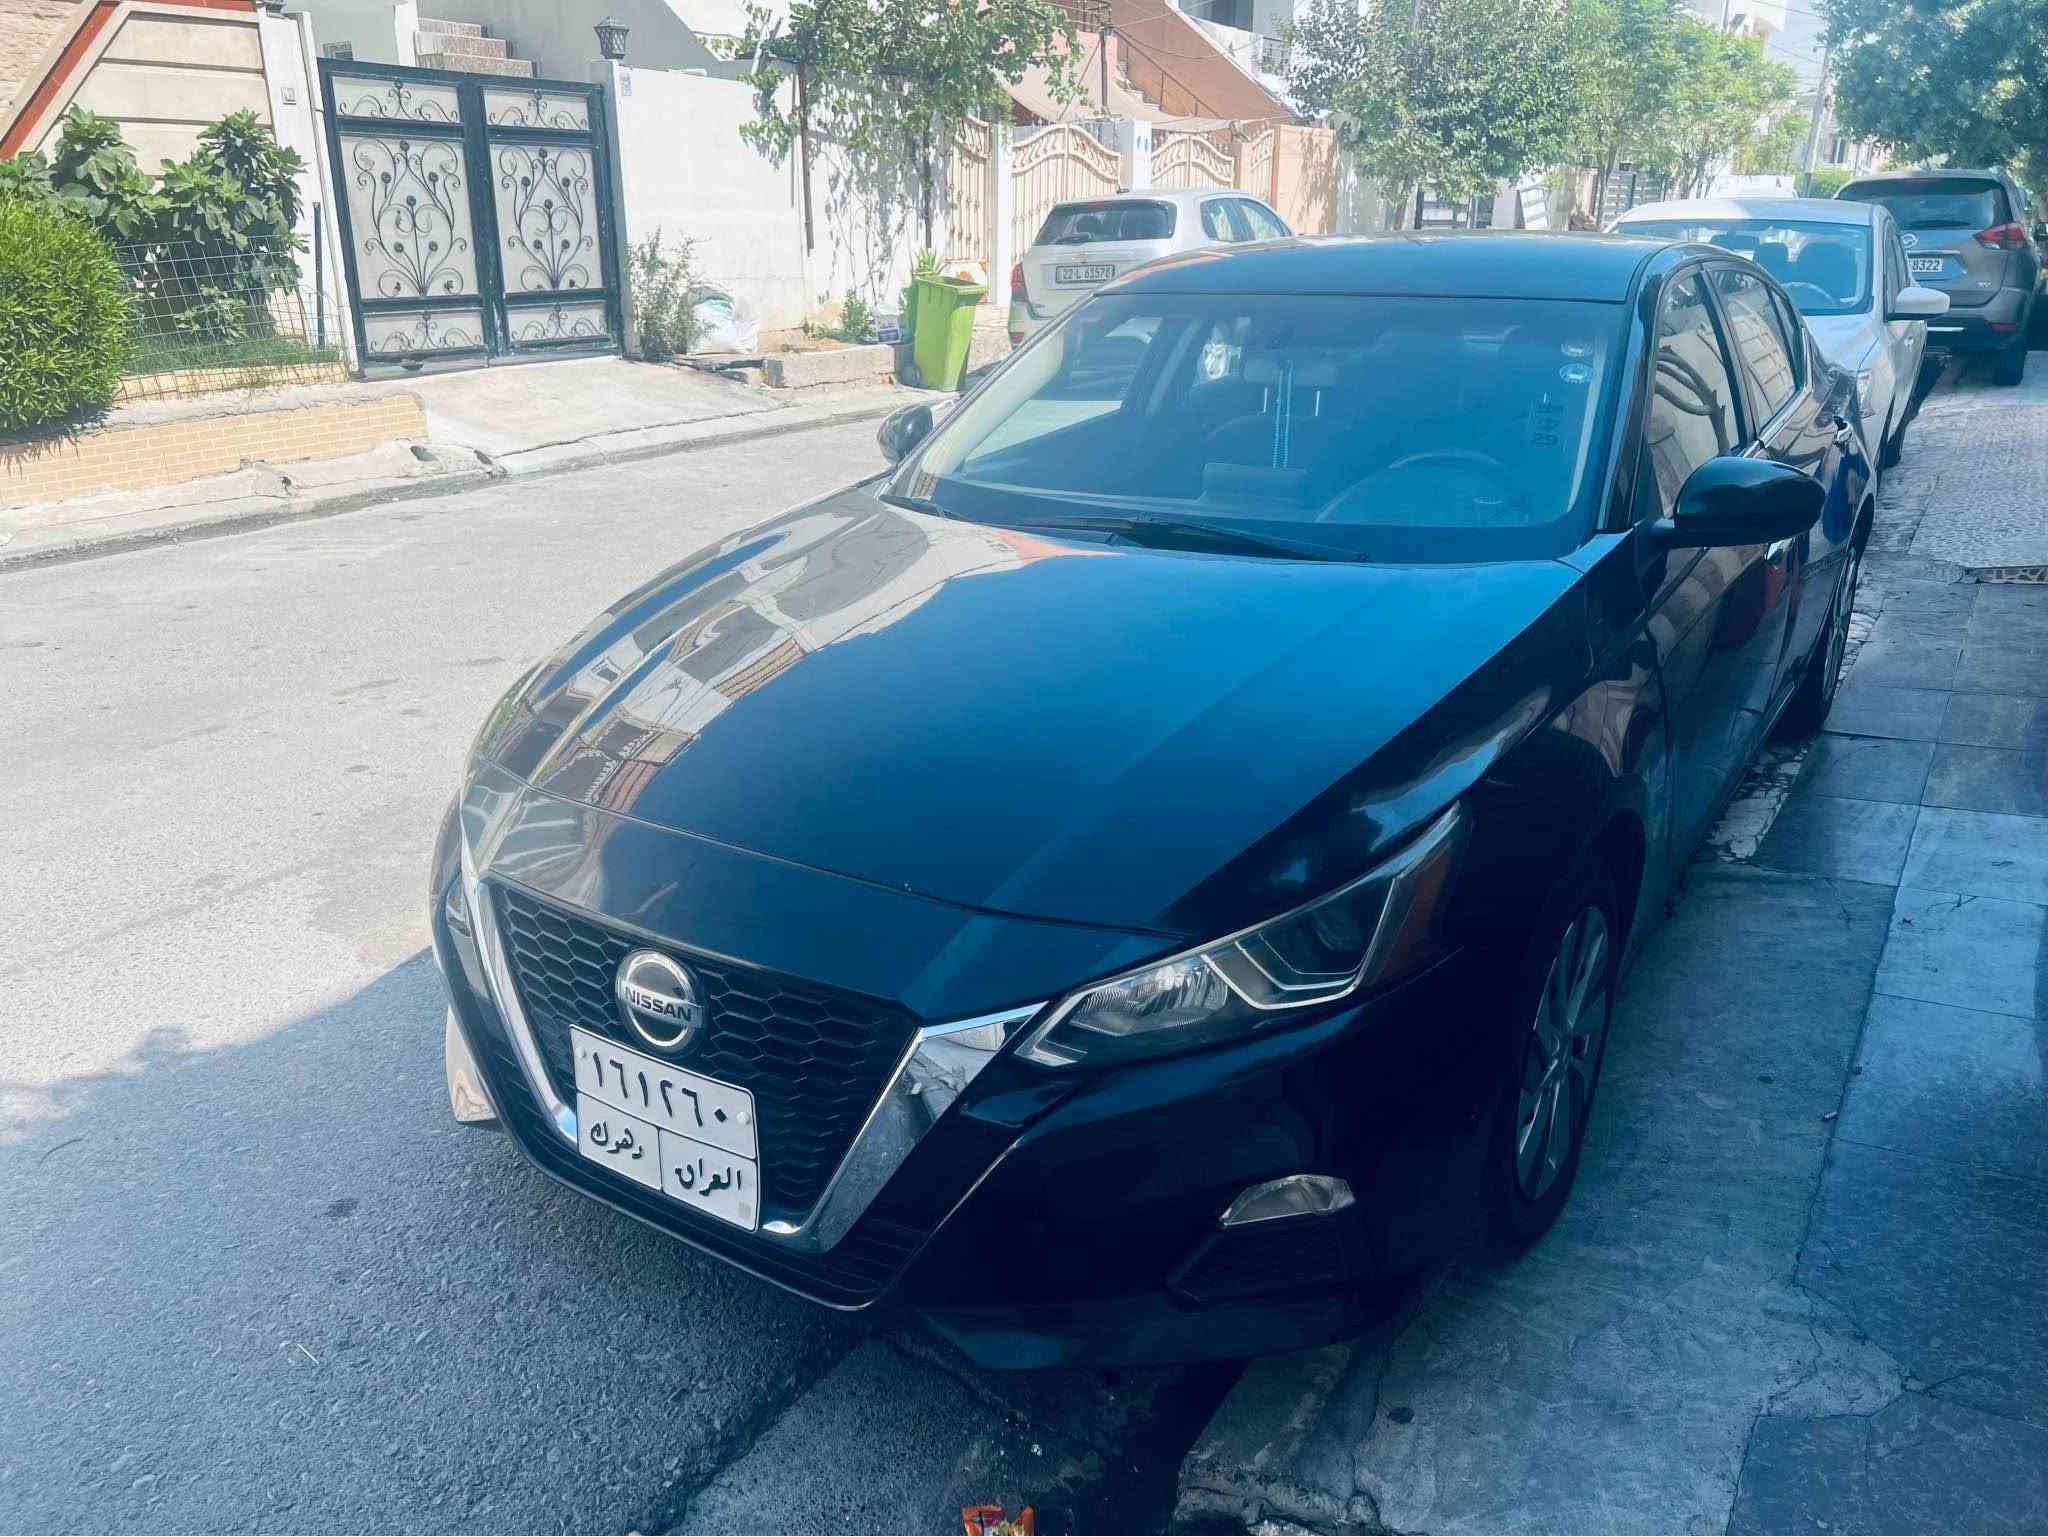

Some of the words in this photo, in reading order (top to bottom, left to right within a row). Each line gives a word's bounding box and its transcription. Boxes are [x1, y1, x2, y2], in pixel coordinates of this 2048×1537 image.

[1908, 259, 1940, 271] 8322
[624, 986, 691, 1022] NISSAN
[593, 1052, 727, 1127] ١٦١٢٦٠
